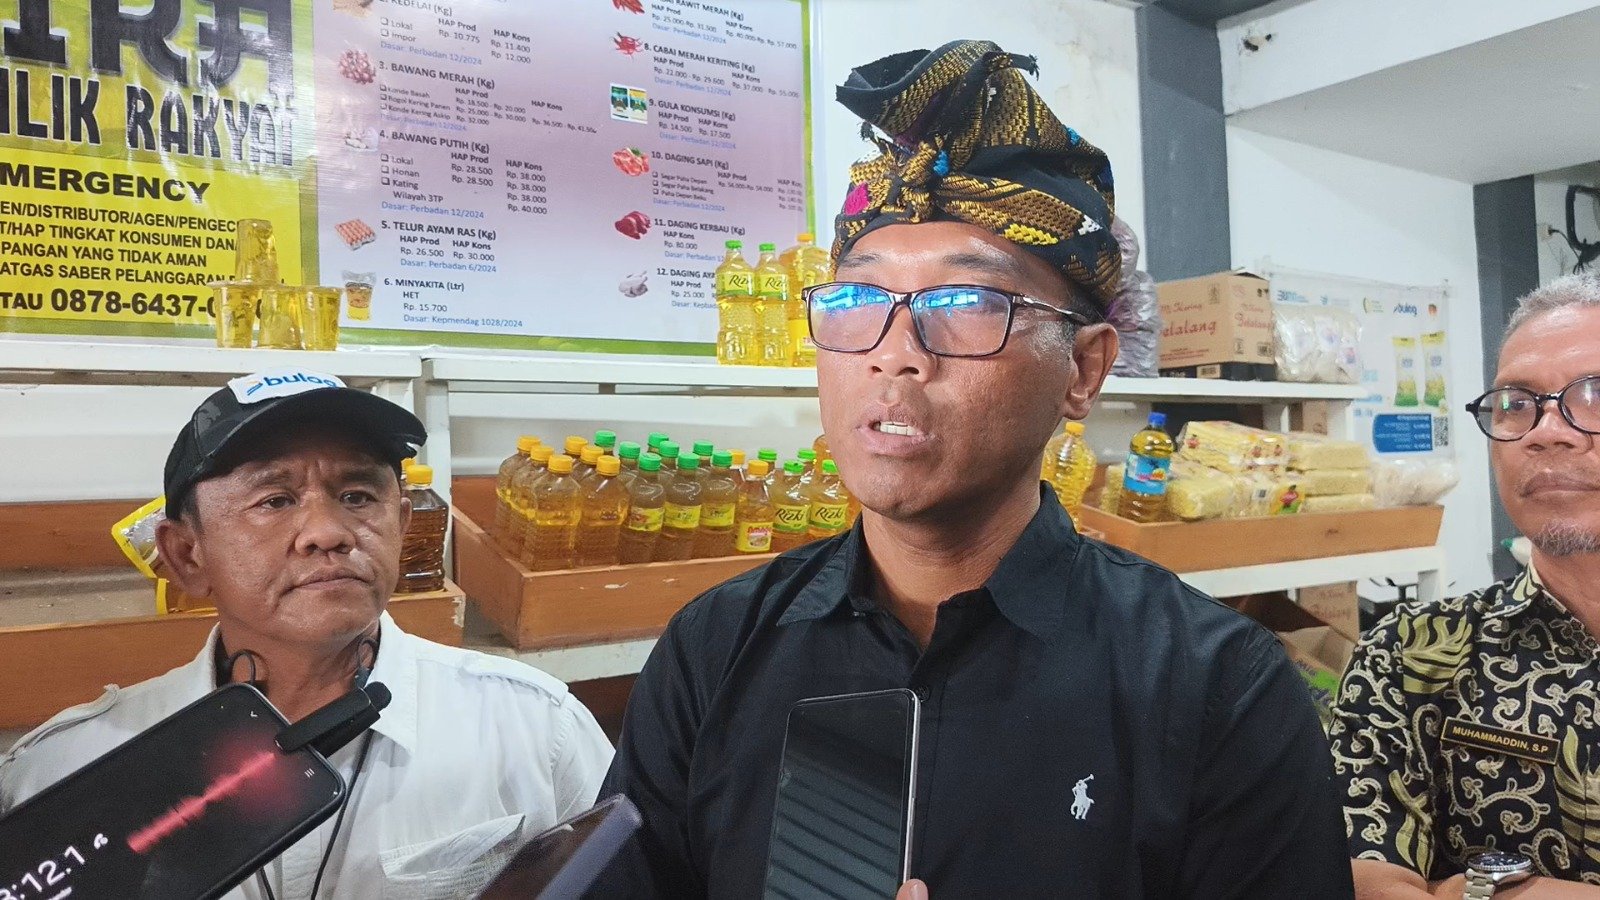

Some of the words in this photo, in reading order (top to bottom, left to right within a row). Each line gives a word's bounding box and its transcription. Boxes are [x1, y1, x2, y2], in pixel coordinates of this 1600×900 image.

[438, 18, 455, 26] HAP
[457, 22, 476, 31] Prod
[494, 29, 510, 37] HAP
[512, 32, 530, 42] Kons
[678, 50, 705, 63] MERAH
[379, 61, 388, 70] 3.
[391, 63, 436, 78] BAWANG
[439, 71, 475, 84] MERAH
[477, 77, 495, 90] (Kg)
[455, 88, 470, 96] HAP
[472, 89, 489, 99] Prod
[658, 101, 679, 111] GULA
[380, 130, 389, 139] 4.
[392, 132, 437, 146] BAWANG
[440, 138, 469, 150] PUTIH
[471, 142, 490, 154] (Kg)
[451, 153, 468, 161] HAP
[470, 155, 489, 164] Prod
[392, 168, 420, 177] Honan
[451, 164, 464, 173] Rp.
[466, 166, 493, 175] 28.500
[506, 160, 522, 168] HAP
[524, 162, 543, 172] Kons
[0, 162, 210, 203] MERGENCY
[392, 179, 418, 190] Kating
[452, 175, 464, 184] Rp.
[467, 177, 493, 187] 28.500
[393, 191, 426, 201] Wilayah
[0, 200, 239, 232] EN/DISTRIBUTOR/AGEN/PENGEC
[411, 205, 449, 216] Perbadan
[451, 209, 484, 219] 12/2024
[381, 220, 390, 229] 5.
[393, 221, 424, 232] TELUR
[426, 225, 454, 235] AYAM
[457, 228, 476, 237] RAS
[478, 229, 496, 241] (Kg)
[654, 219, 666, 227] 11.
[668, 220, 698, 230] DAGING
[49, 224, 115, 242] TINGKAT
[120, 230, 201, 249] KONSUMEN
[206, 237, 237, 251] DAN
[679, 232, 695, 240] Kons
[400, 235, 418, 243] HAP
[420, 237, 440, 246] Prod
[452, 240, 470, 248] HAP
[472, 242, 491, 251] Kons
[1, 241, 68, 258] PANGAN
[72, 246, 114, 261] YANG
[118, 249, 162, 264] TIDAK
[166, 252, 207, 267] AMAN
[400, 247, 412, 256] Rp.
[416, 248, 444, 258] 26.500
[453, 251, 465, 260] Rp.
[468, 253, 495, 261] 30.000
[0, 261, 53, 277] ATGAS
[58, 265, 111, 280] SABER
[429, 261, 466, 270] Perbadan
[468, 263, 497, 273] 6/2024
[657, 268, 668, 276] 12.
[670, 269, 700, 278] DAGING
[384, 278, 393, 286] 6.
[395, 279, 445, 289] MINYAKITA
[447, 281, 465, 292] (Ltr)
[0, 292, 43, 310] TAU
[403, 291, 420, 299] HET
[403, 303, 415, 312] Rp.
[419, 303, 448, 312] 15.700
[432, 315, 480, 327] Kepmendag
[482, 318, 523, 328] 1028/2024
[1160, 319, 1216, 337] elalang
[1453, 726, 1529, 750] MUHAMMADDIN,
[1532, 743, 1549, 753] S.P
